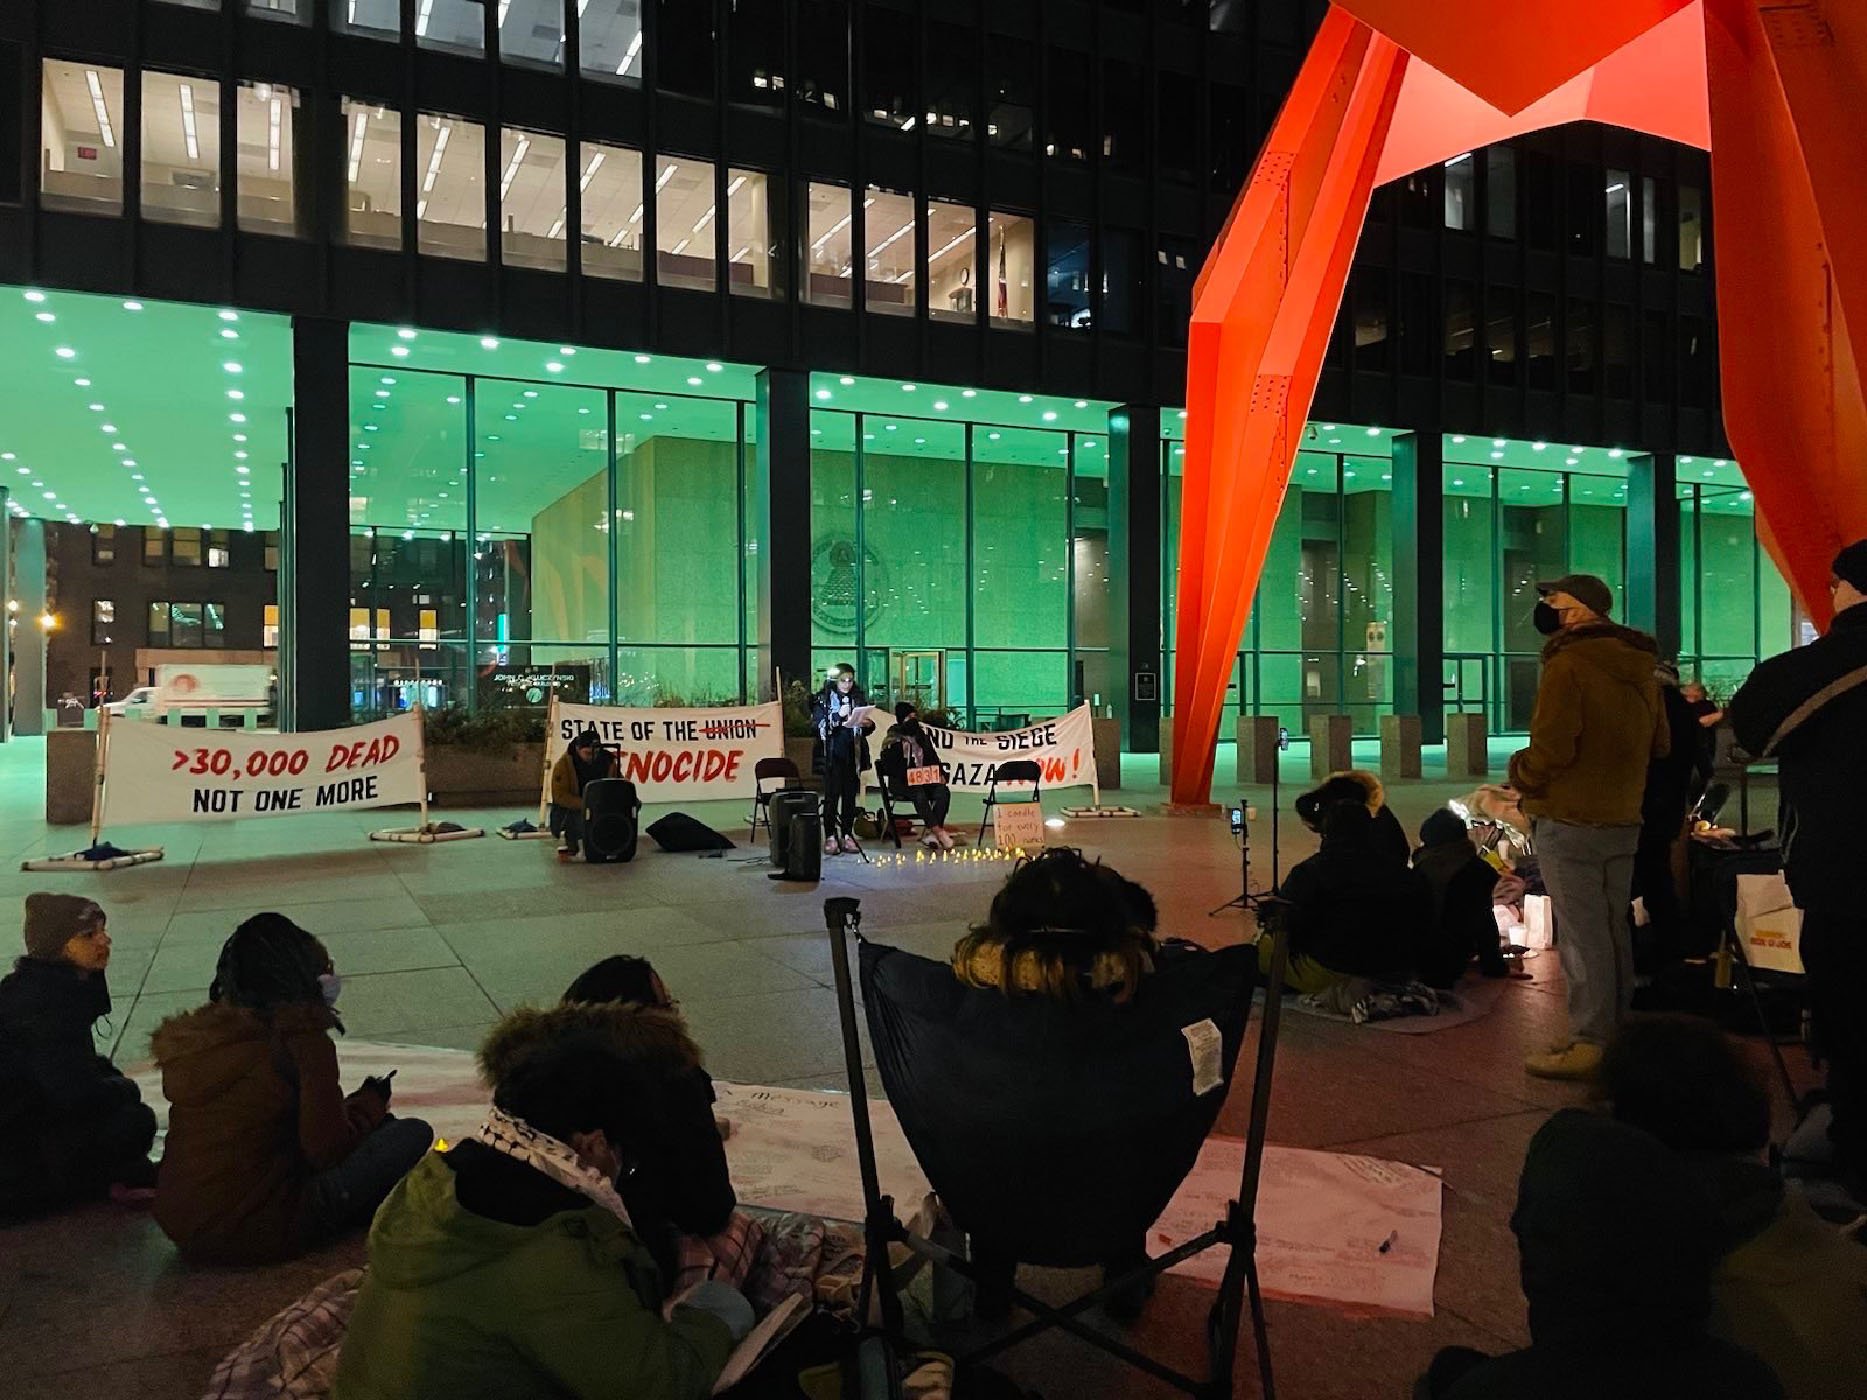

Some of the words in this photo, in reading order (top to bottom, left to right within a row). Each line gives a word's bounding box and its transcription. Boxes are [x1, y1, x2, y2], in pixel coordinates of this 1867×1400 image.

[561, 719, 625, 741] STATE
[631, 721, 656, 741] OF
[663, 720, 699, 742] THE
[705, 719, 757, 739] UNION
[923, 726, 954, 750] ND
[964, 735, 988, 746] THE
[999, 722, 1058, 750] SIEGE
[172, 748, 309, 781] >30,000
[325, 734, 400, 773] DEAD
[617, 750, 745, 784] NOCIDE
[193, 788, 244, 813] NOT
[255, 788, 304, 812] ONE
[316, 776, 379, 808] MORE
